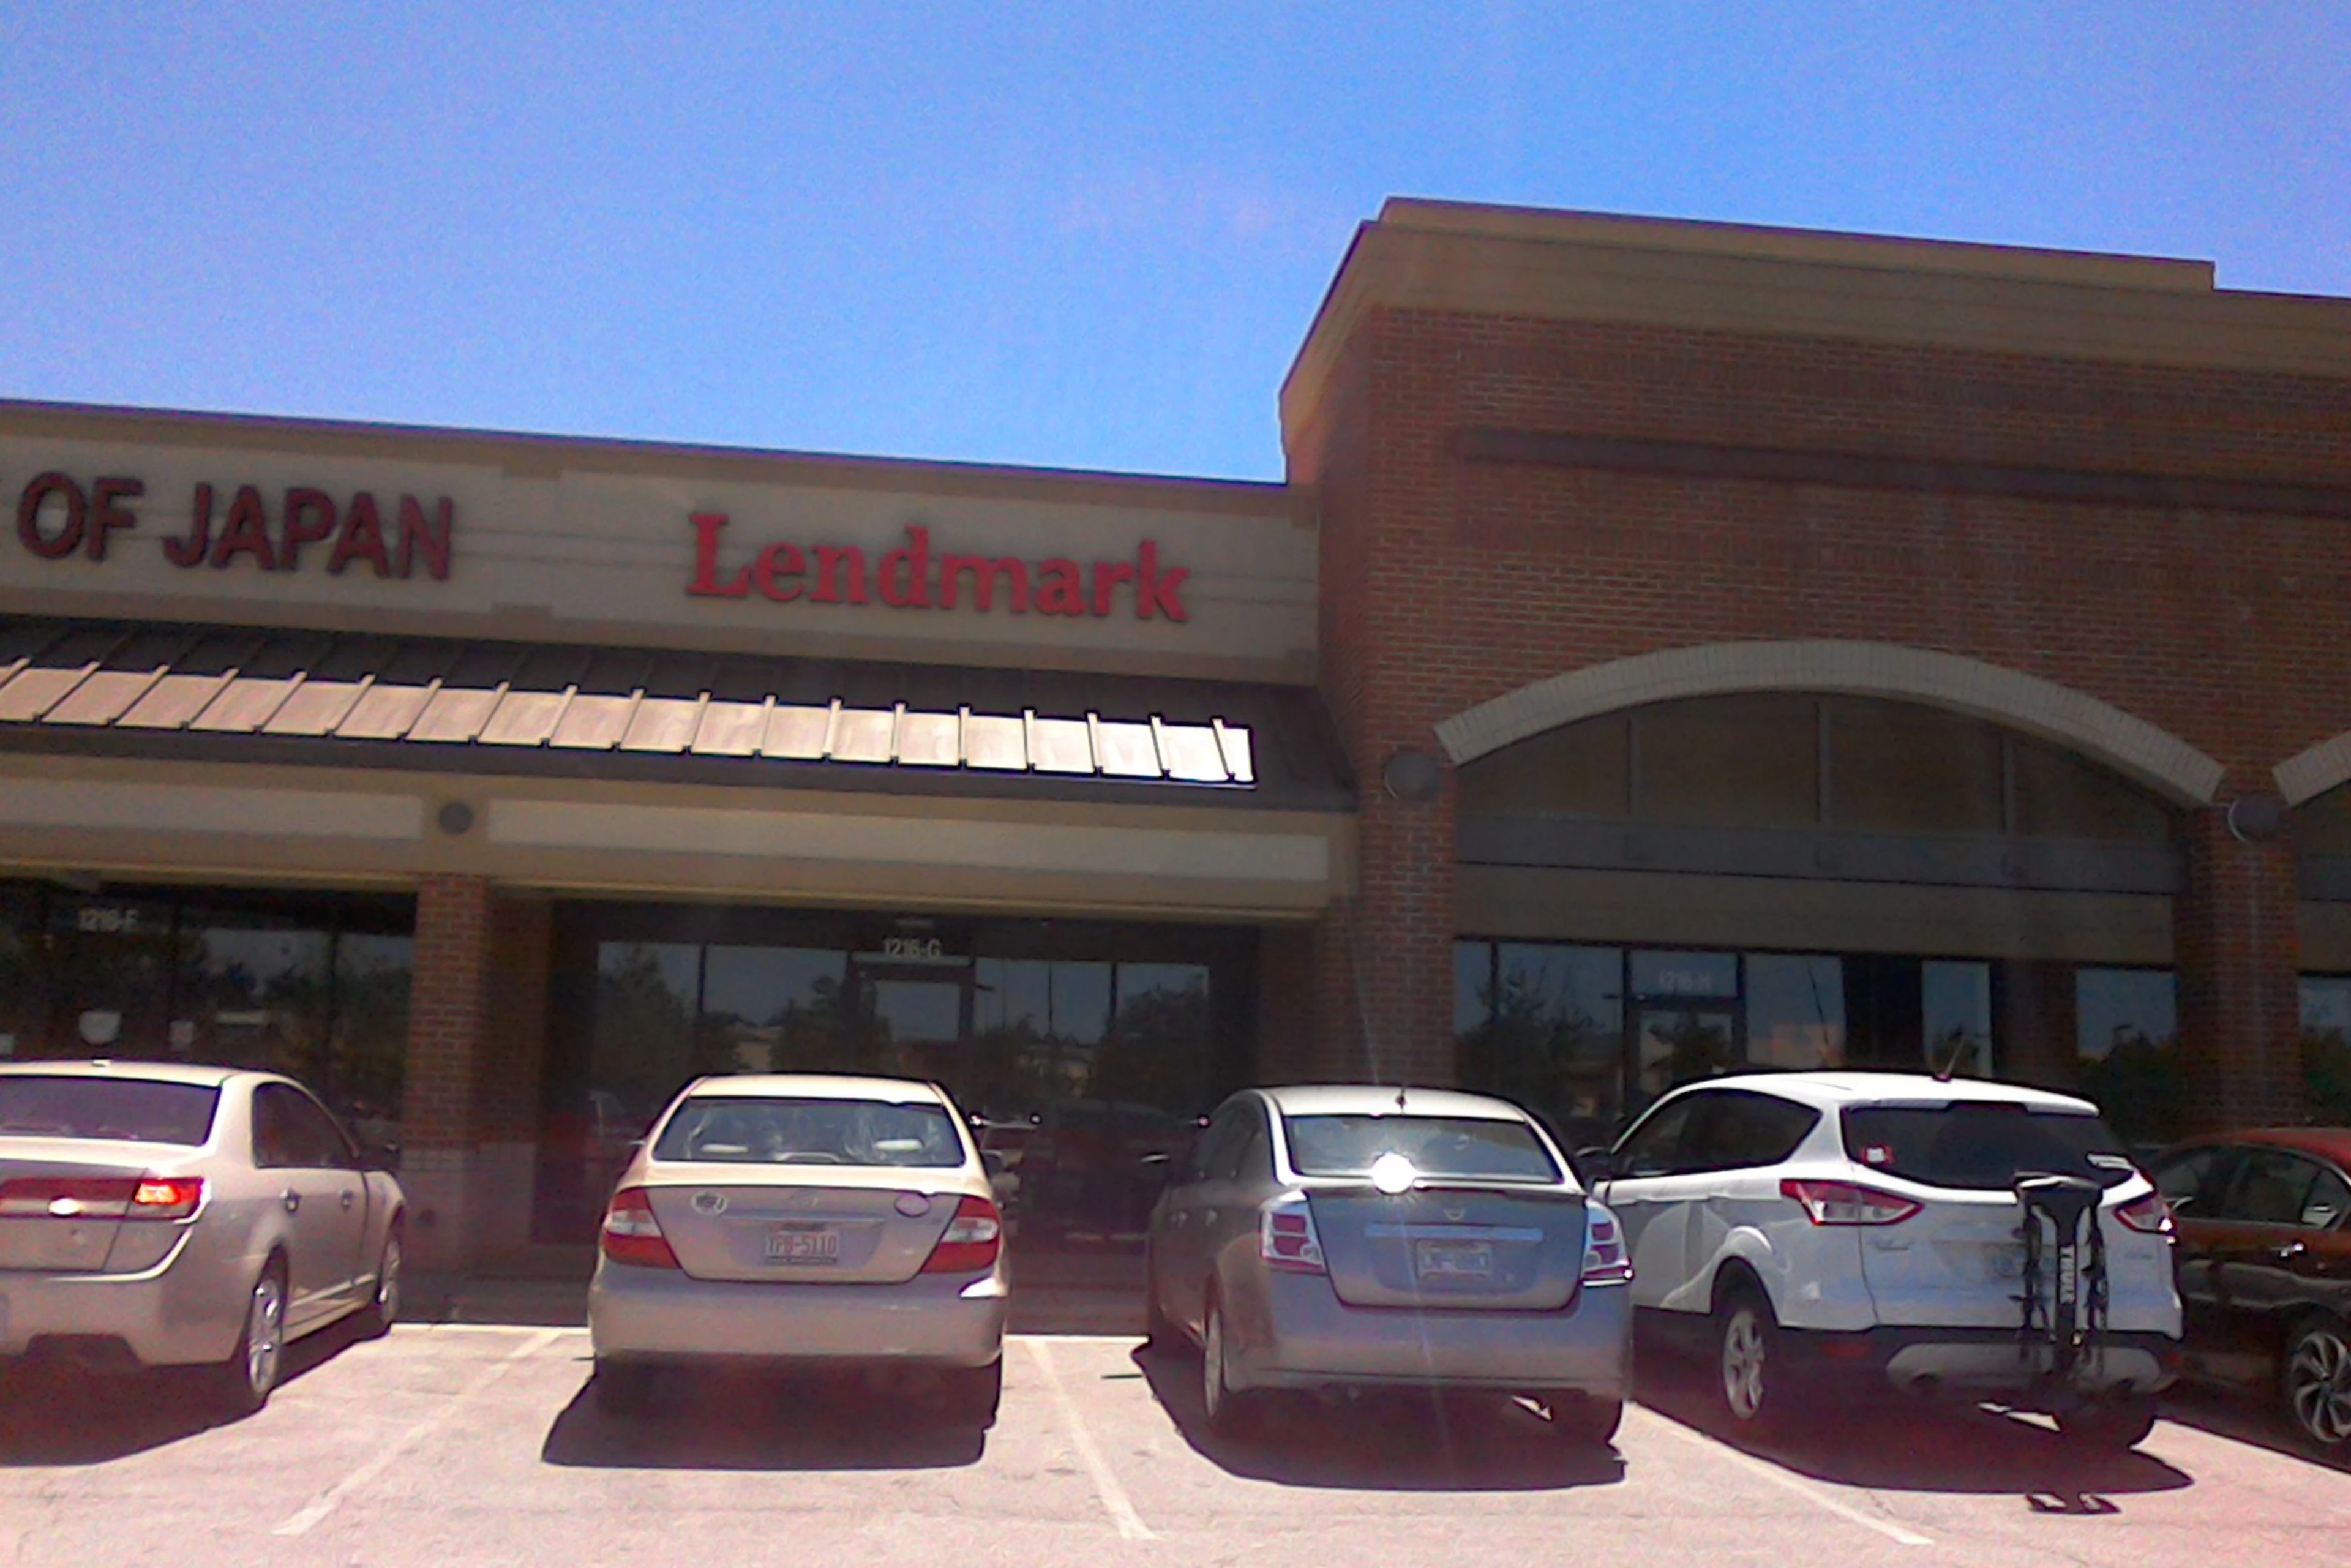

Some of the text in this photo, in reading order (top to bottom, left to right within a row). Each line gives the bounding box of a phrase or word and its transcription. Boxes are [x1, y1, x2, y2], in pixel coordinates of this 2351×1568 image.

[17, 471, 454, 580] OF JAPAN
[685, 512, 1190, 622] Lendmark
